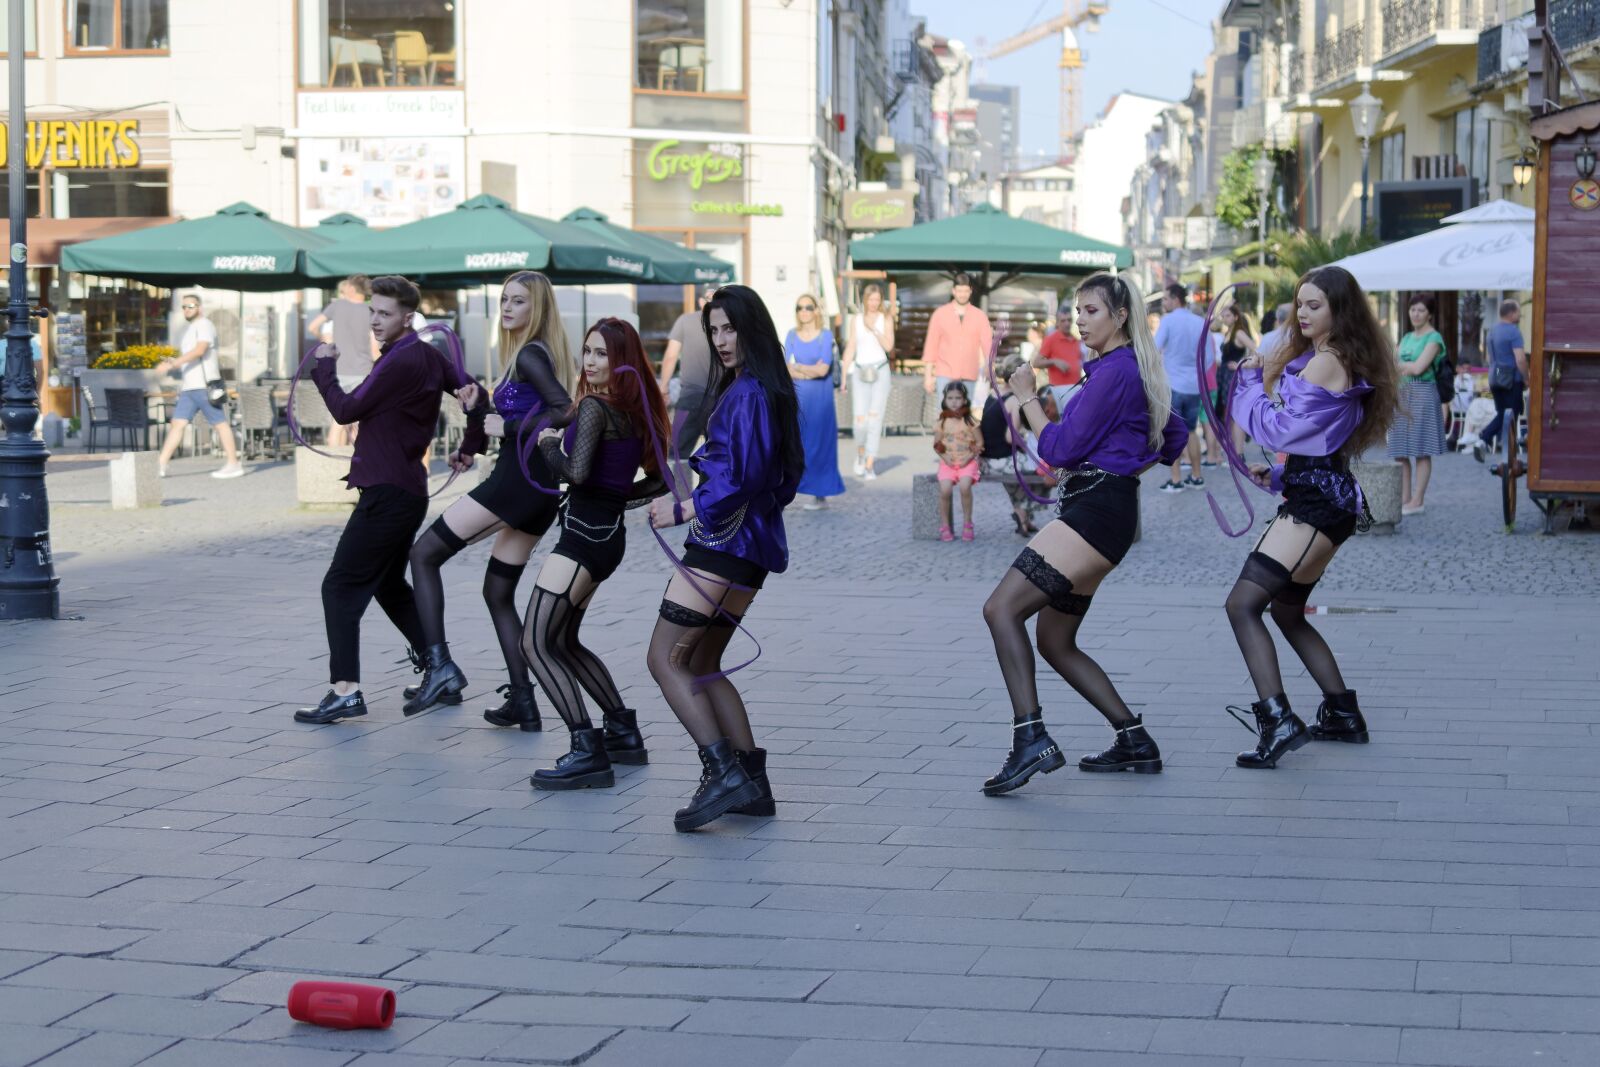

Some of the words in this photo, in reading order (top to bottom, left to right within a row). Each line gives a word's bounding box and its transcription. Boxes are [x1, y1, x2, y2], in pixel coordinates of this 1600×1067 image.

[304, 96, 329, 114] Feel
[333, 96, 356, 113] like
[386, 95, 423, 113] Greek
[0, 119, 140, 168] VENIRS
[648, 140, 742, 190] Gregorys
[1438, 231, 1517, 267] Coca
[345, 698, 361, 707] LEFT
